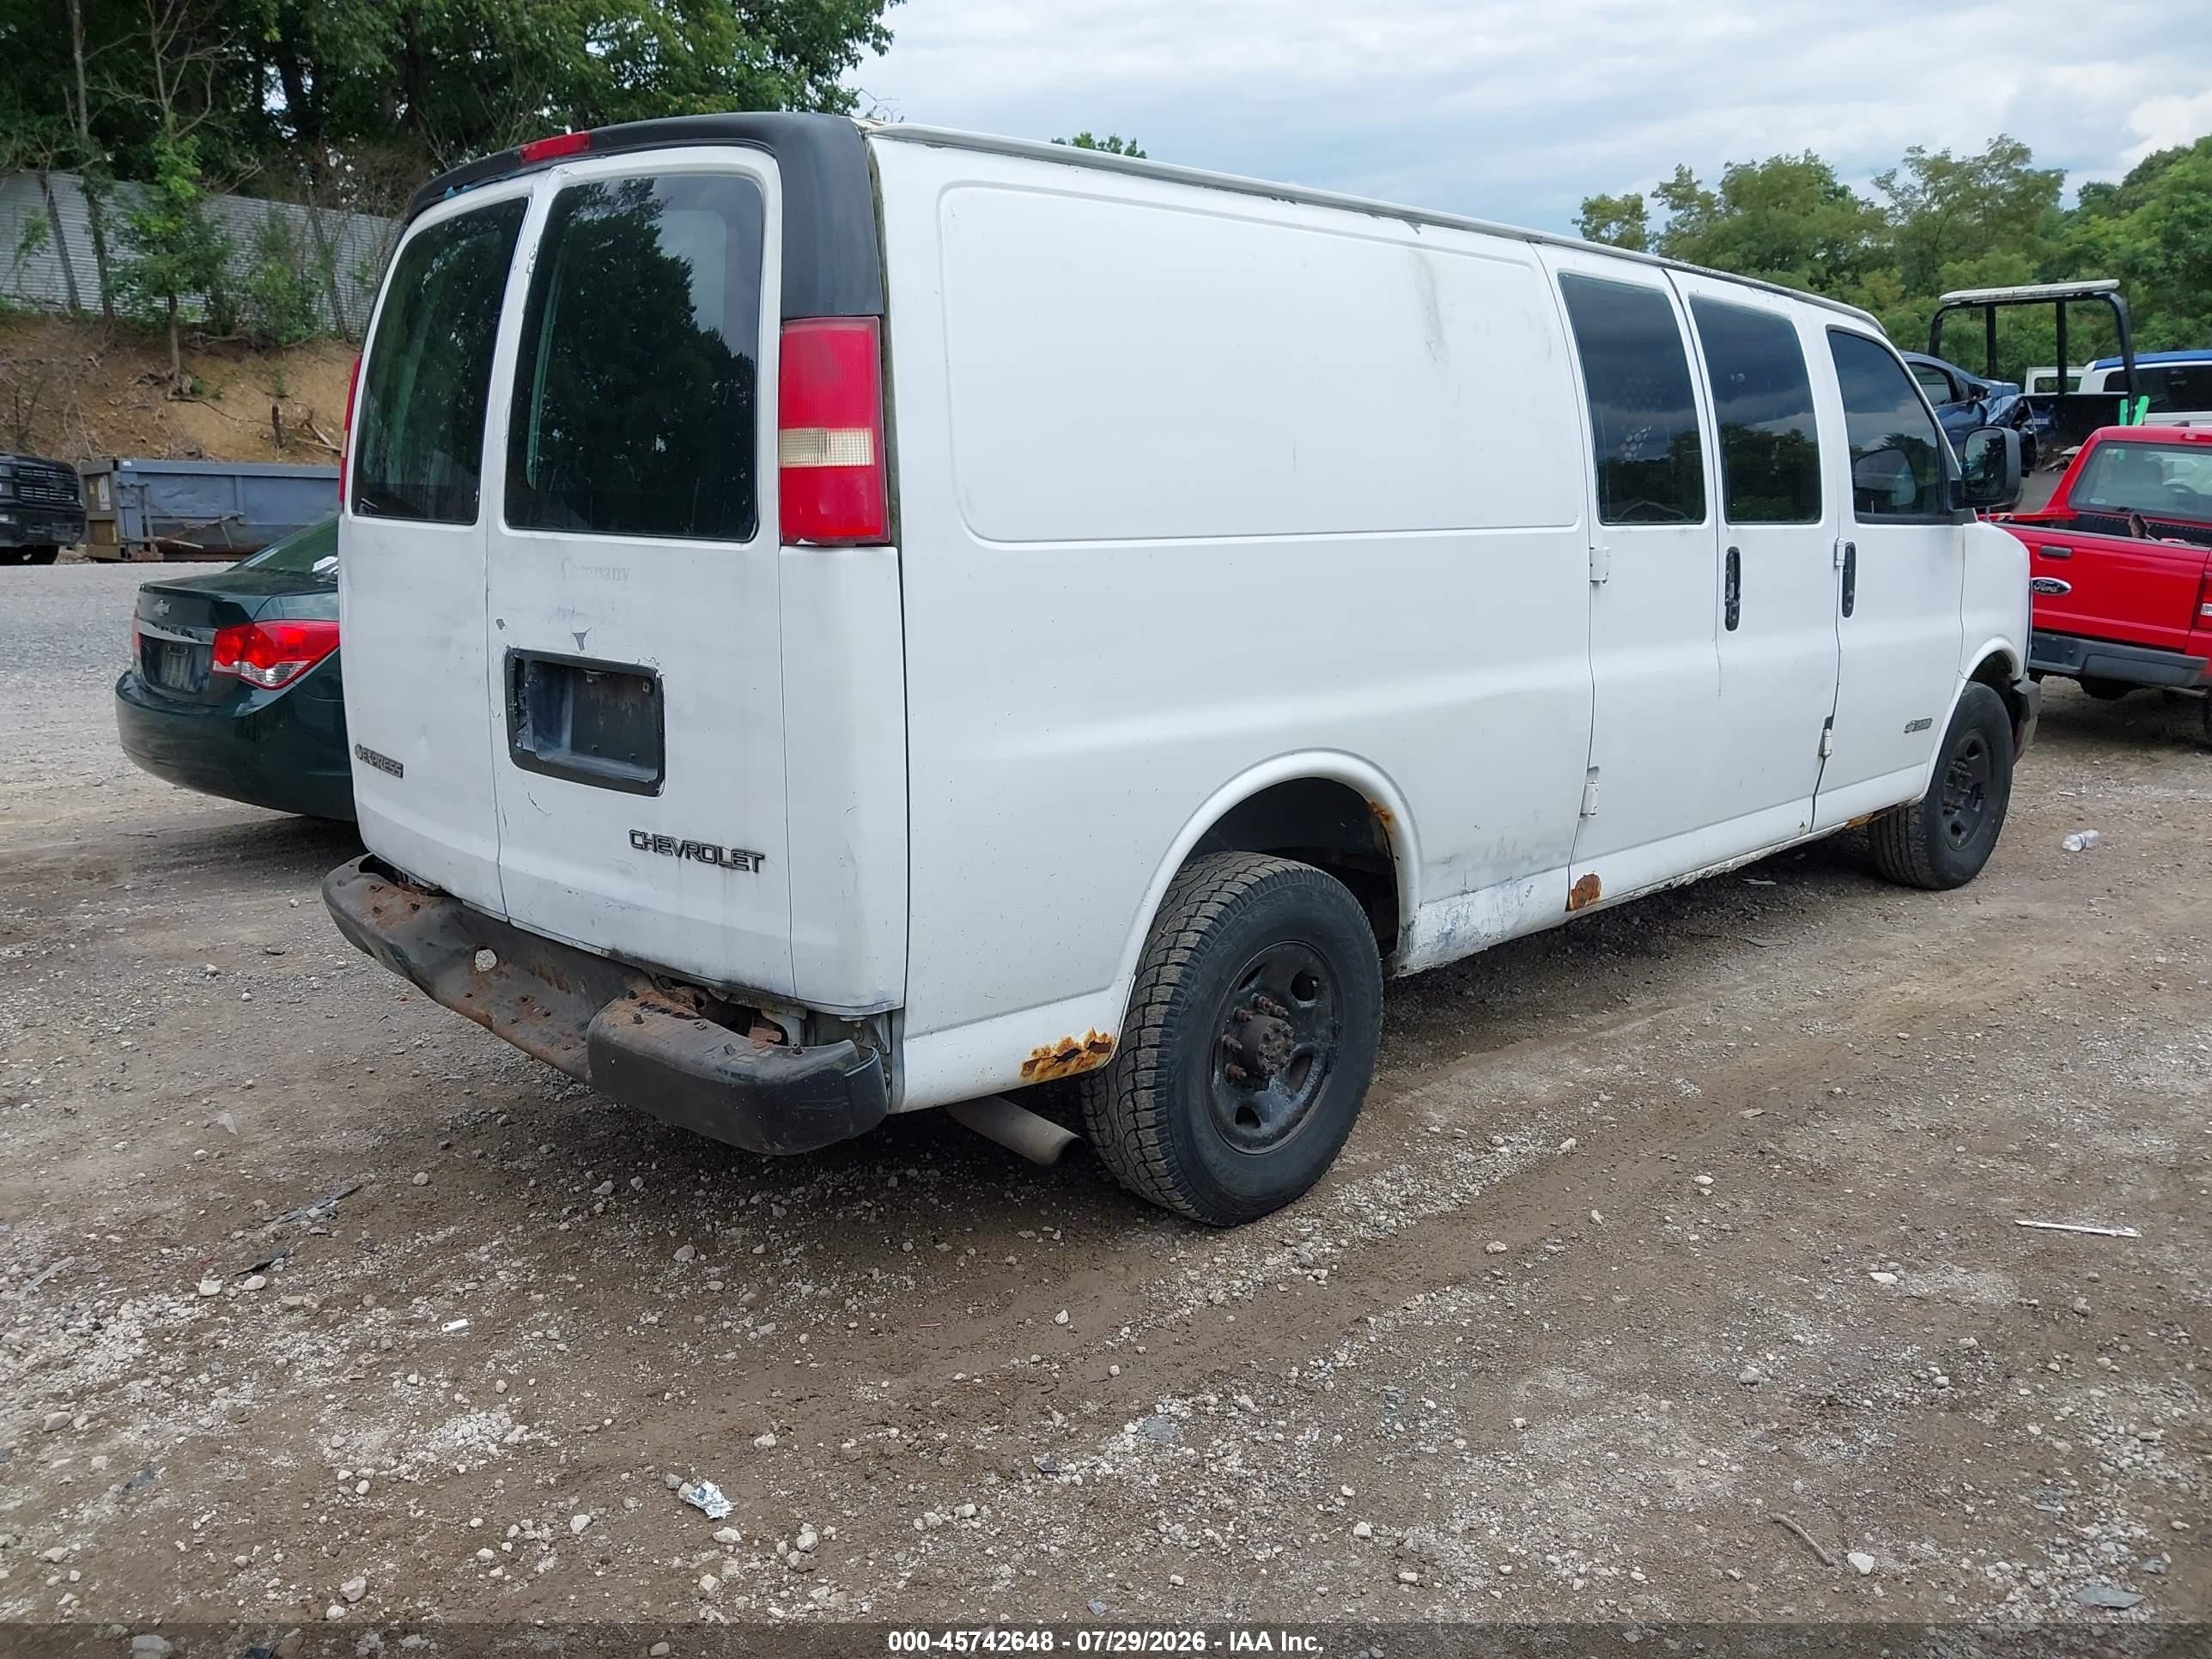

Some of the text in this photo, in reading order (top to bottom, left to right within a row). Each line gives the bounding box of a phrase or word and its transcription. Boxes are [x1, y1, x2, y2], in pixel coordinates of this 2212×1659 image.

[561, 557, 631, 590] Cmpany
[2033, 580, 2061, 592] Ford
[362, 747, 404, 779] EXPRESS
[629, 829, 766, 873] CHEVROLET
